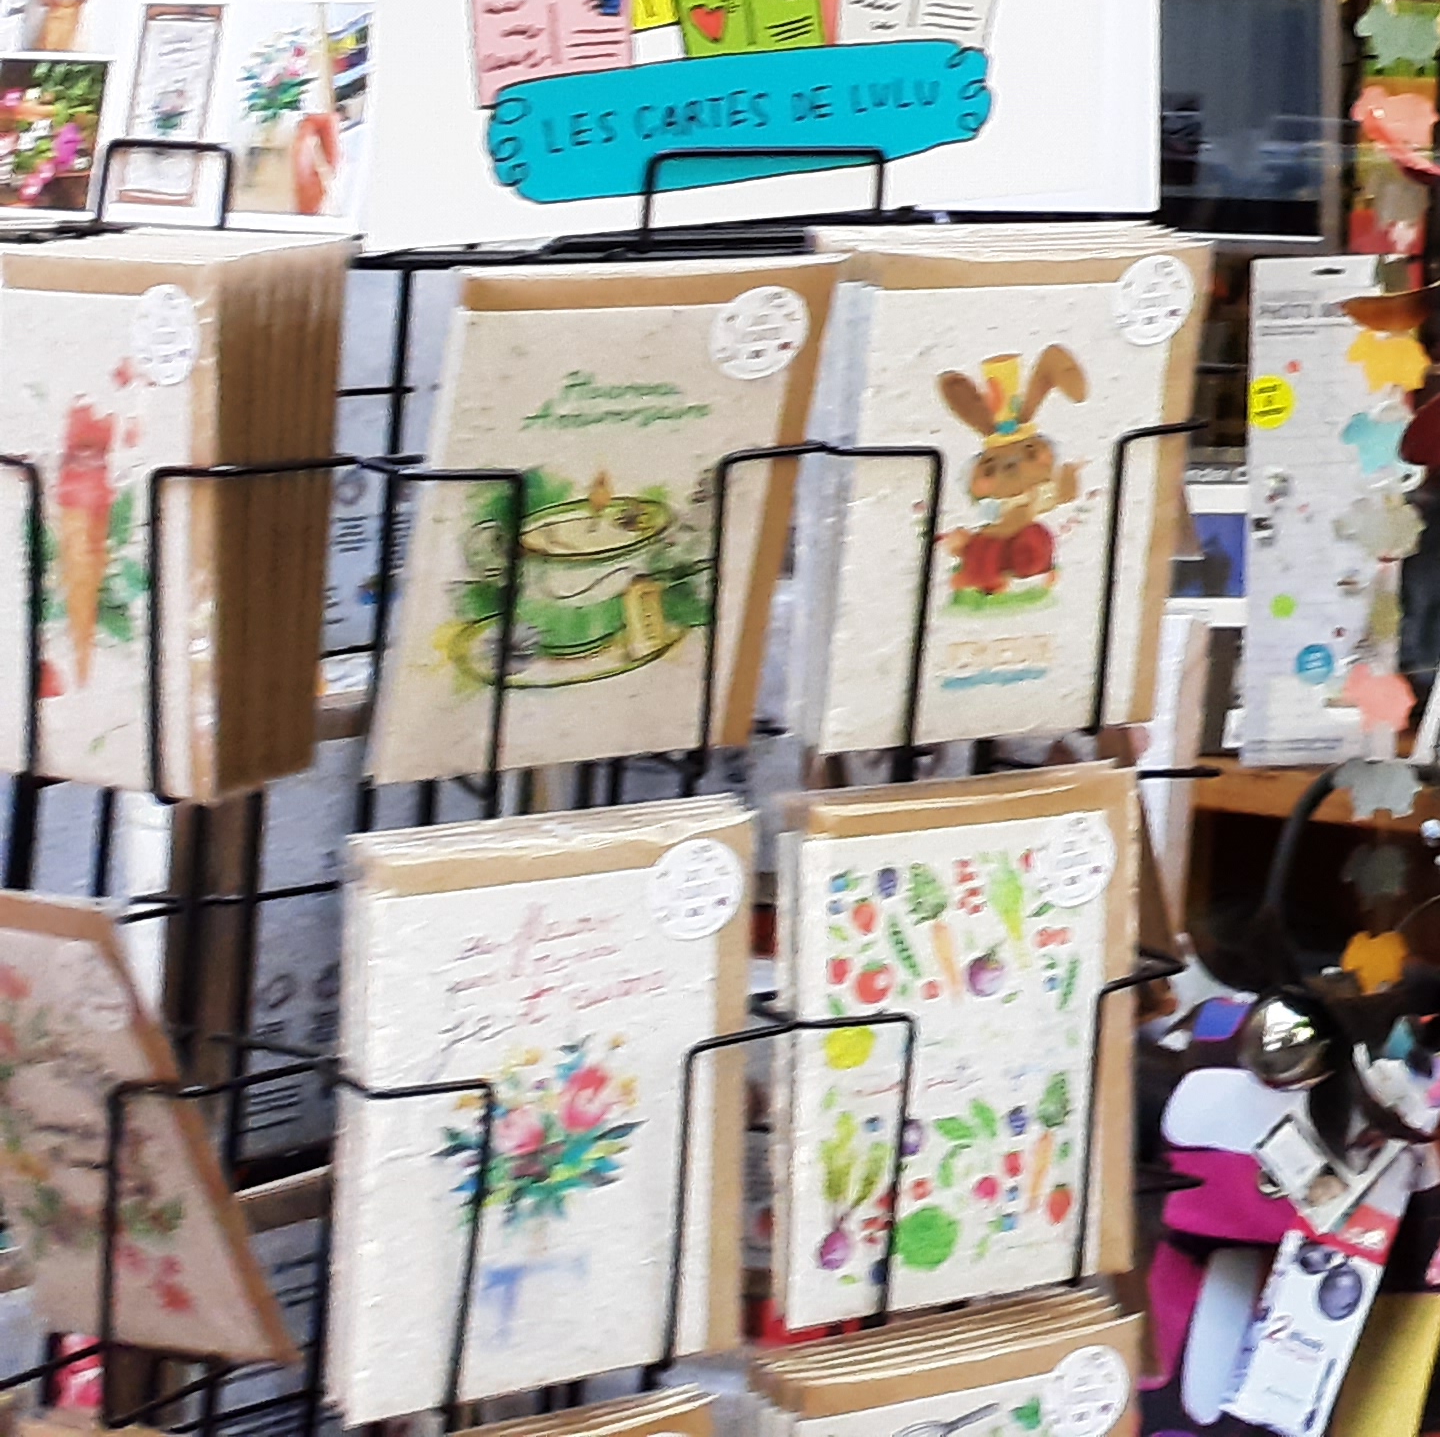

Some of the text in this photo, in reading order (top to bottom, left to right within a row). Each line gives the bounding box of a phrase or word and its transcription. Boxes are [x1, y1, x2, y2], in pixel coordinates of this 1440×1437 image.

[539, 76, 942, 154] LES CARTES DE LULU
